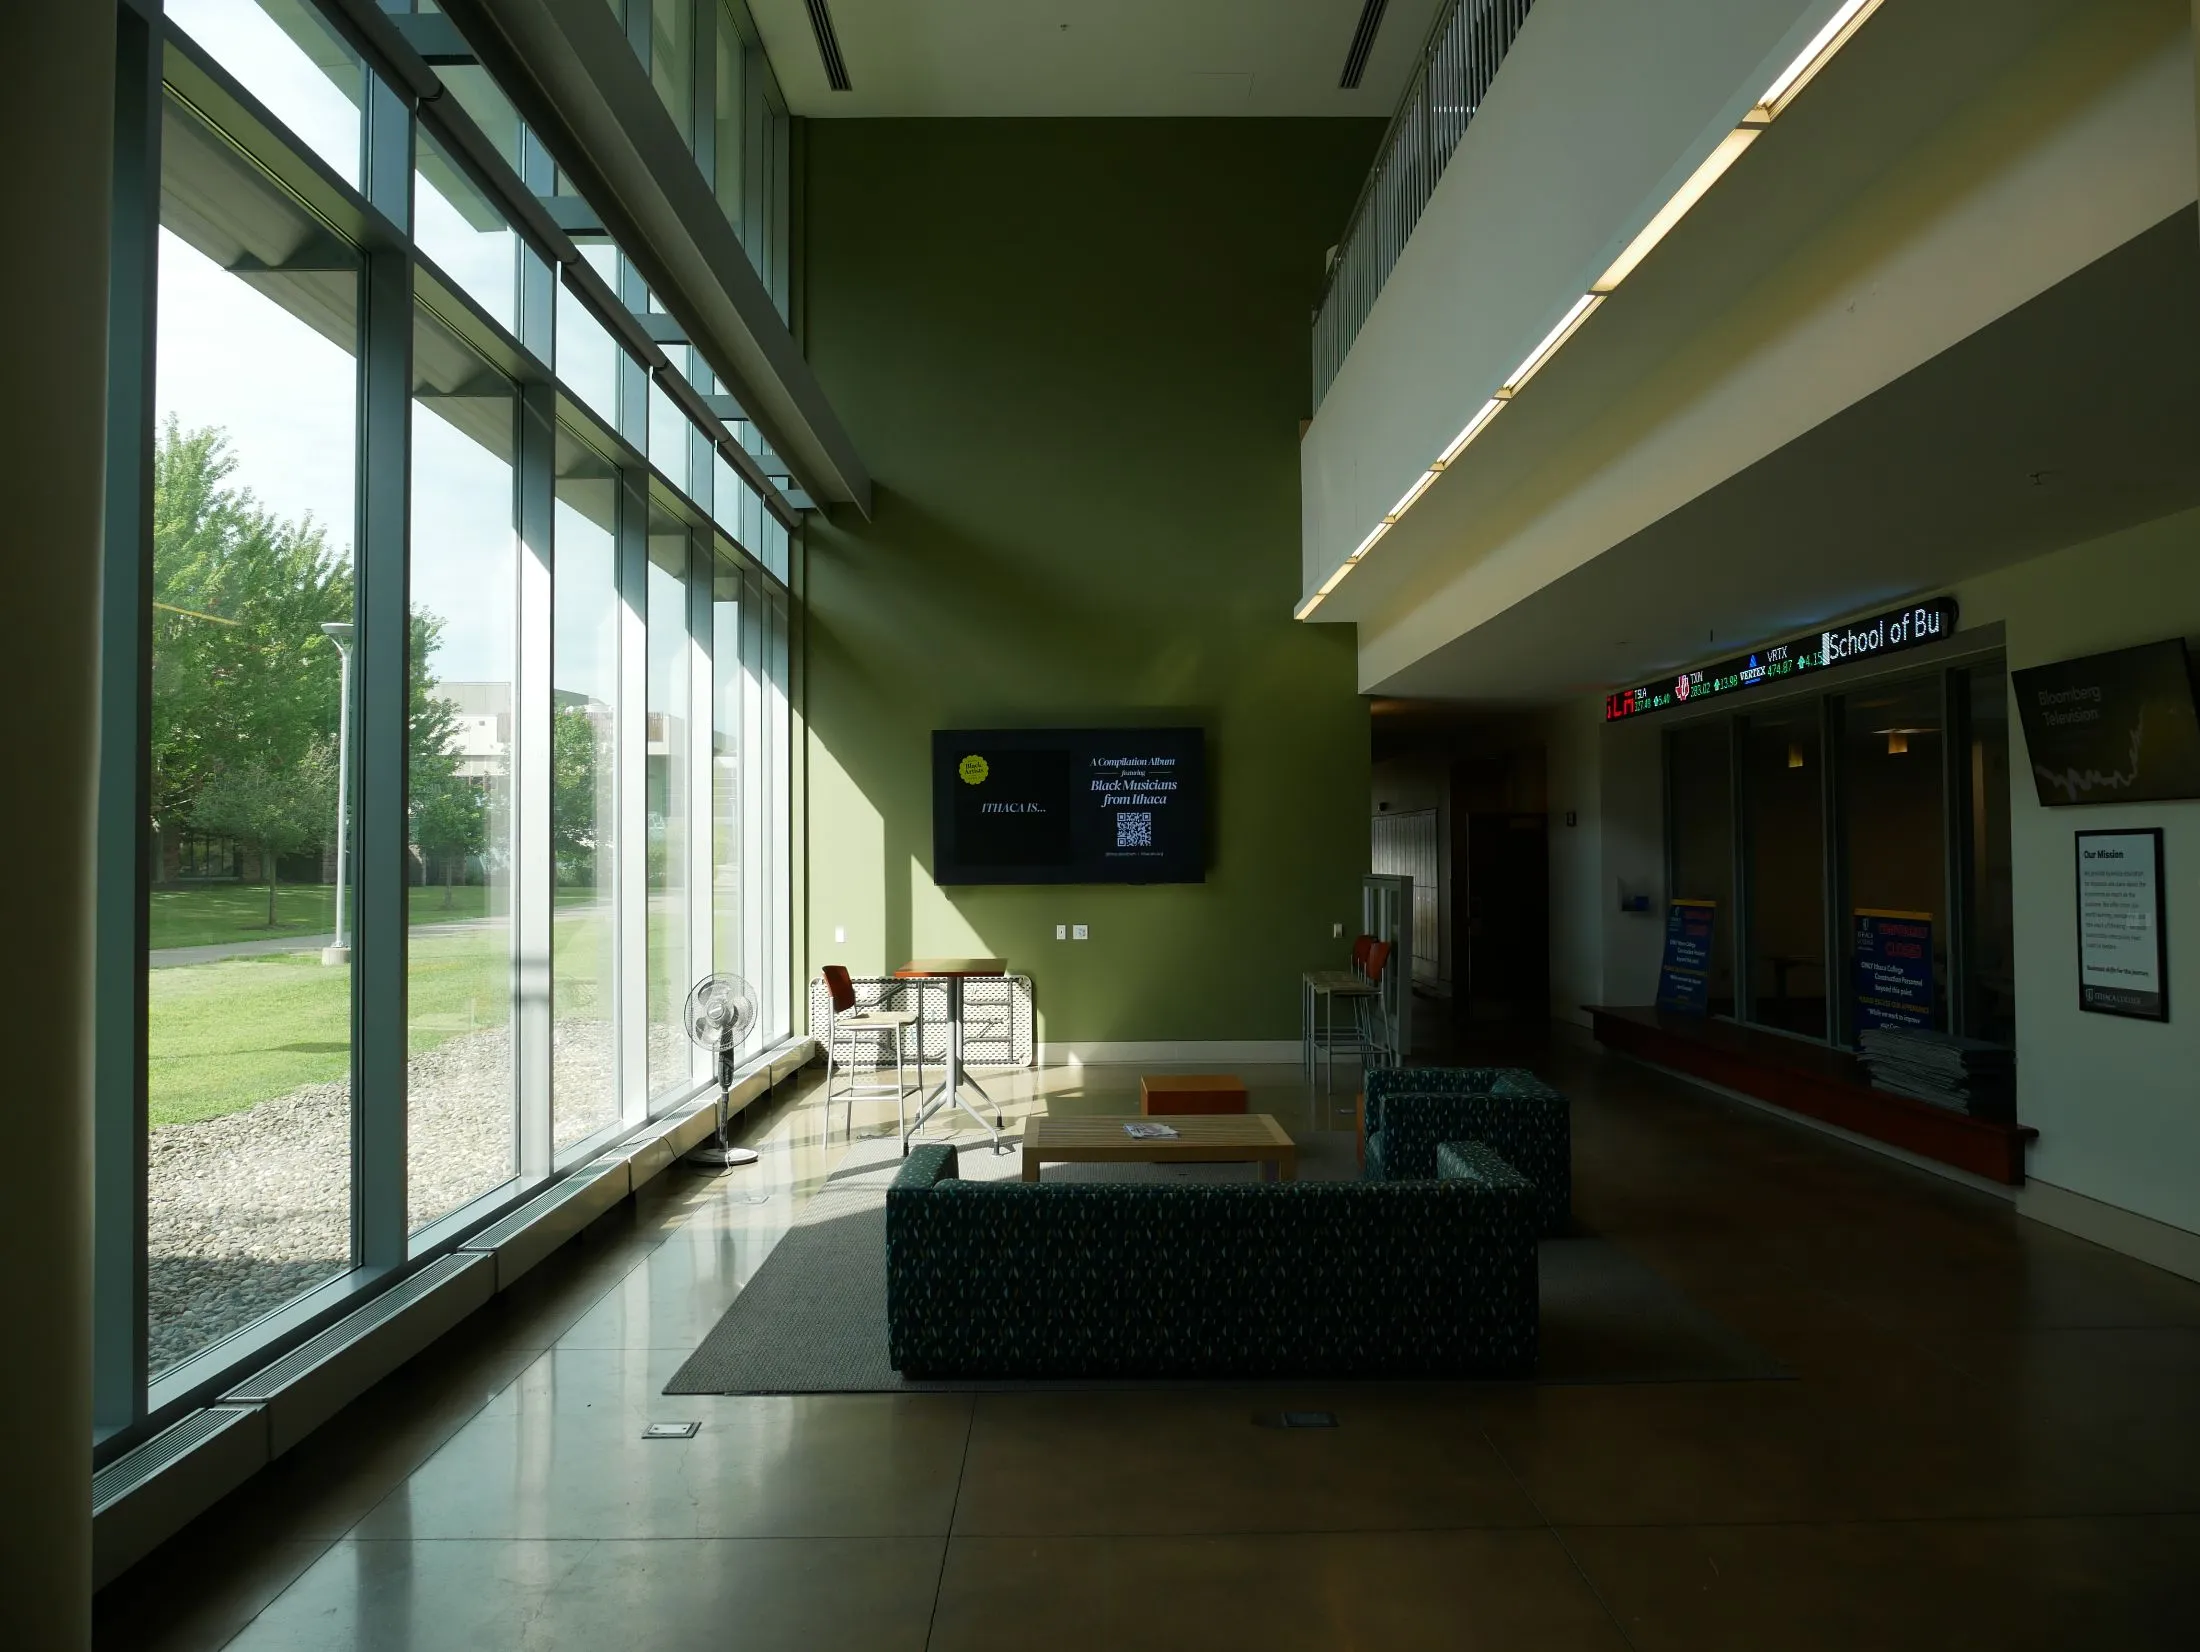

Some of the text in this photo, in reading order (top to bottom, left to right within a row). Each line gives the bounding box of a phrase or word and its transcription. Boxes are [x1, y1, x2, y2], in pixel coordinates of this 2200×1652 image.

[1829, 608, 1940, 660] School of Bu
[1766, 645, 1788, 662] VRTX
[1739, 665, 1767, 682] VERTEX
[2037, 684, 2102, 706] Bloomberg
[2041, 706, 2100, 727] Television
[1089, 757, 1176, 768] A Compilation Album
[1091, 780, 1178, 791] Black Musicians
[981, 802, 1025, 814] ITHACA
[1102, 793, 1168, 808] from Ithaca
[2083, 848, 2124, 860] Our Mission
